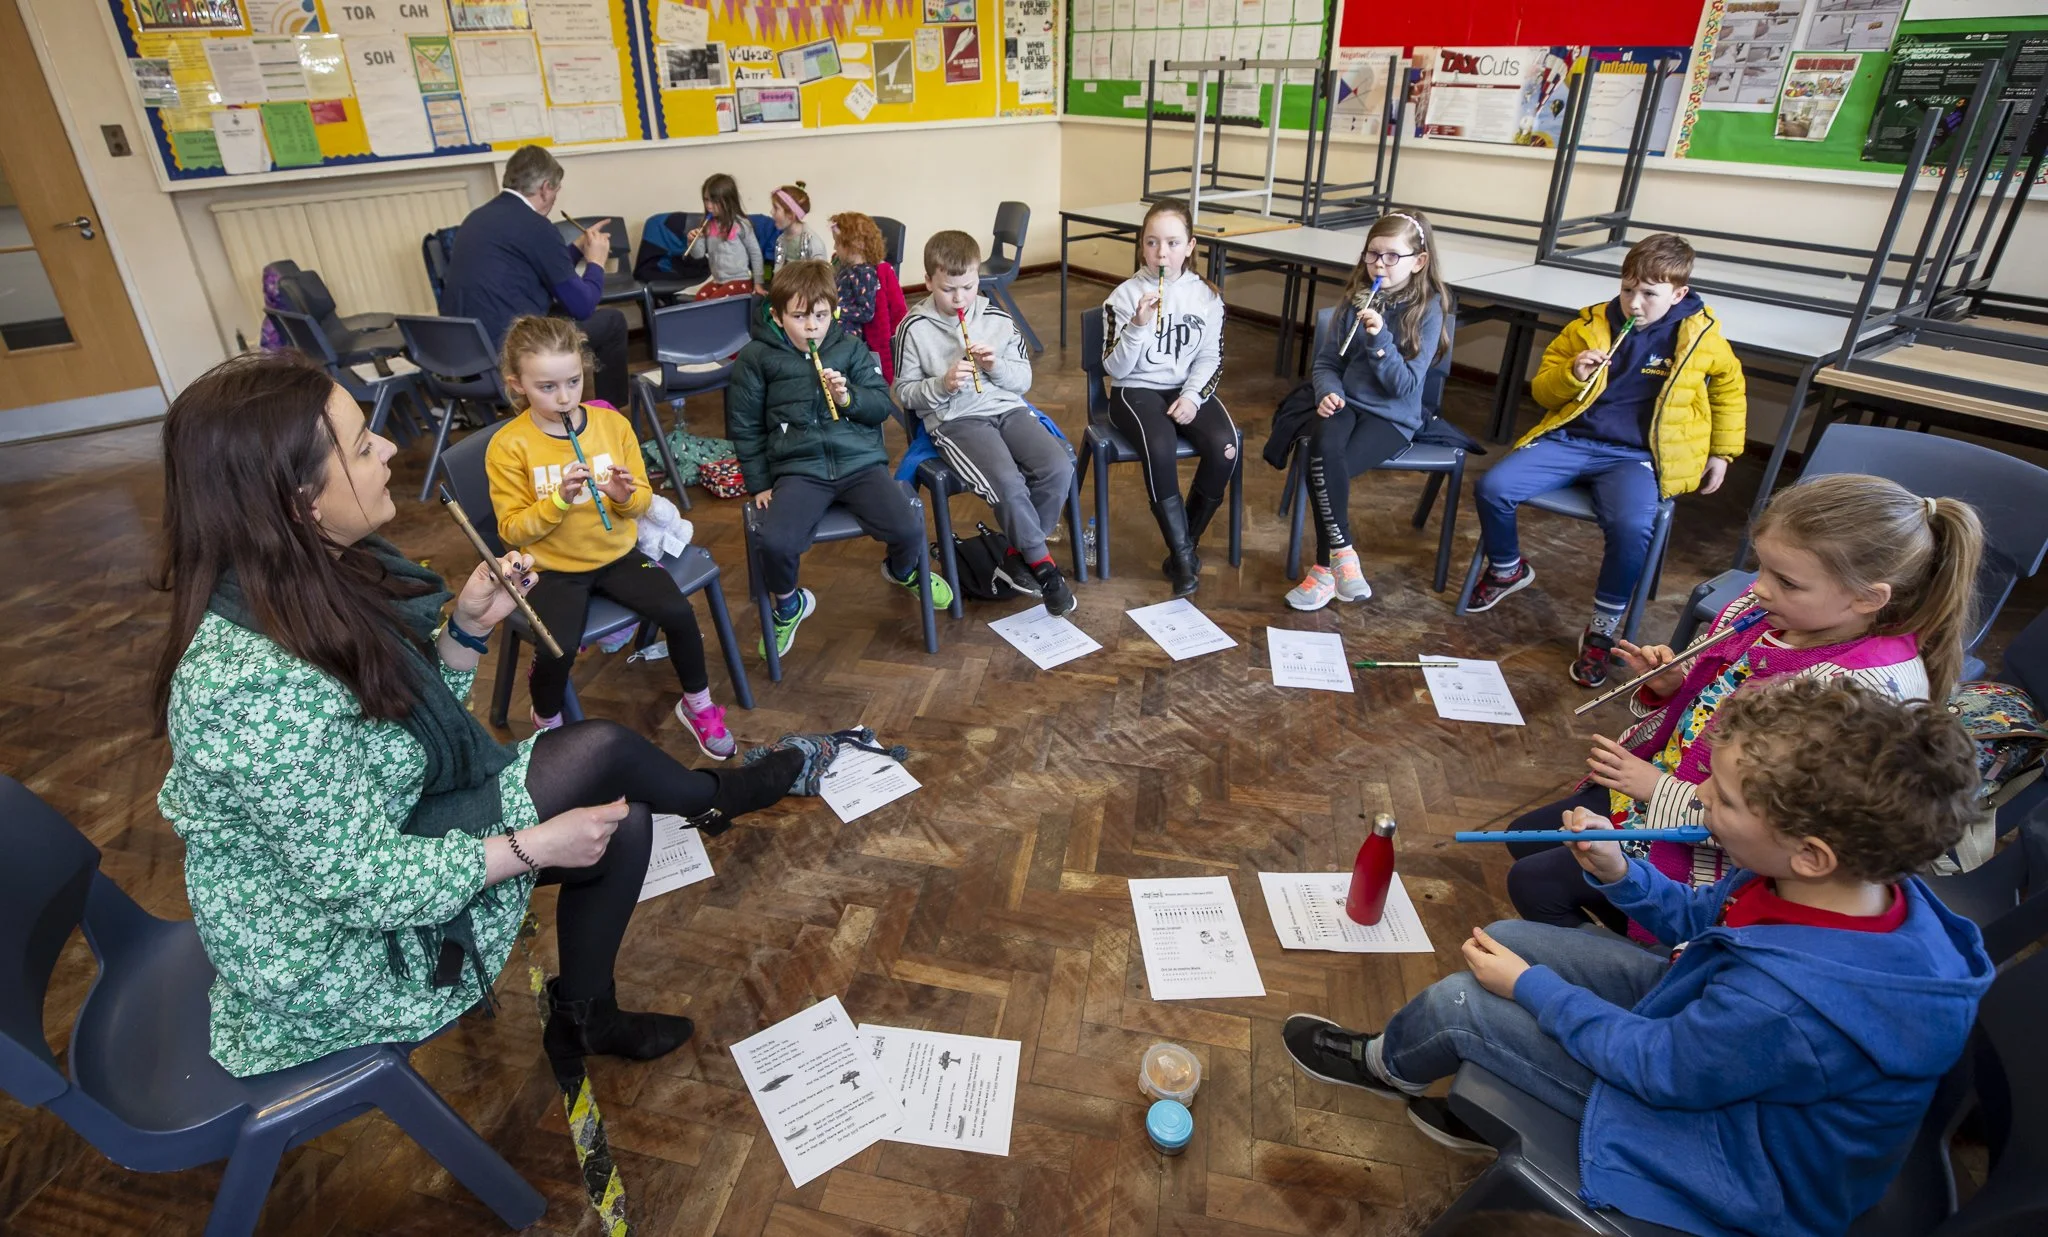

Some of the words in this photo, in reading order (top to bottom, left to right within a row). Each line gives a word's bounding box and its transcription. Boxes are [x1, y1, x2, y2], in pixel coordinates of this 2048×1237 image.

[342, 5, 375, 20] TOA
[400, 4, 429, 18] CAH
[1026, 41, 1045, 49] WHEN
[364, 50, 395, 65] SOH
[1622, 51, 1633, 62] of
